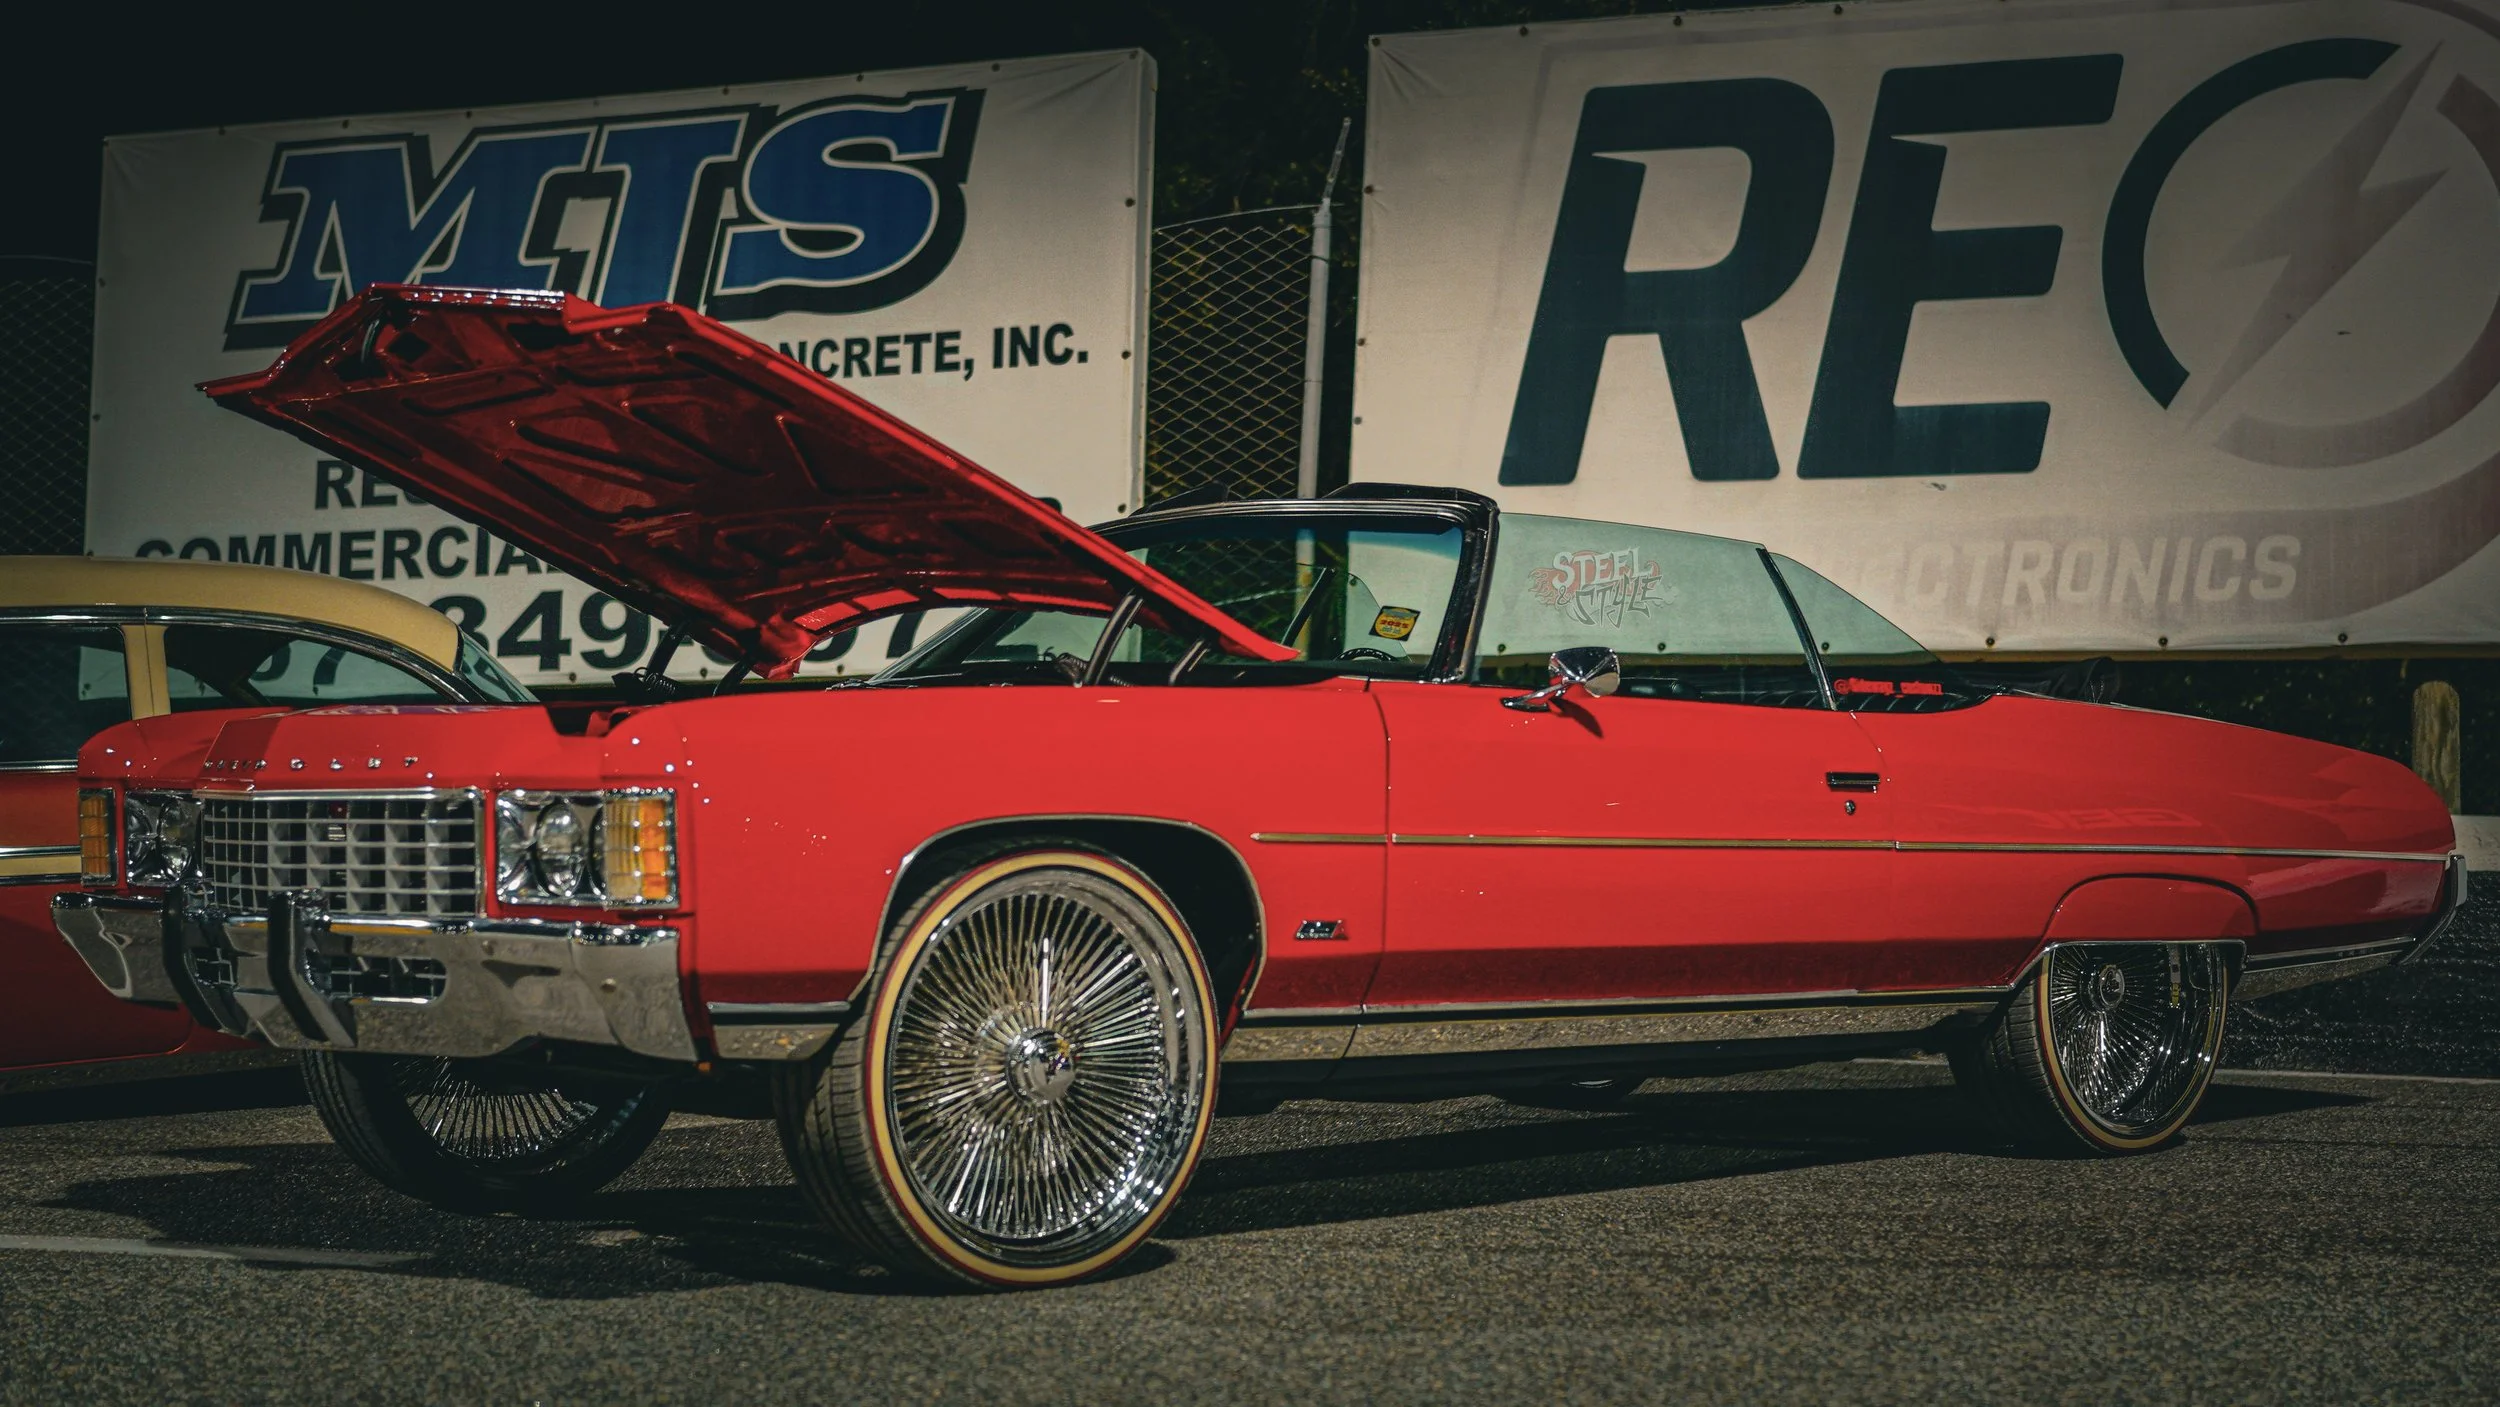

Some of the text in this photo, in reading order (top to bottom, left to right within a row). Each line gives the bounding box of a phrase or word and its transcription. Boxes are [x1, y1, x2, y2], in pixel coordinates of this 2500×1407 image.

[993, 323, 1089, 369] INC.
[314, 459, 428, 511] RE
[134, 526, 564, 581] MMERCIA
[1552, 546, 1655, 591] STEEL
[1868, 534, 2302, 603] CTRONICS
[1574, 574, 1664, 629] STYLE
